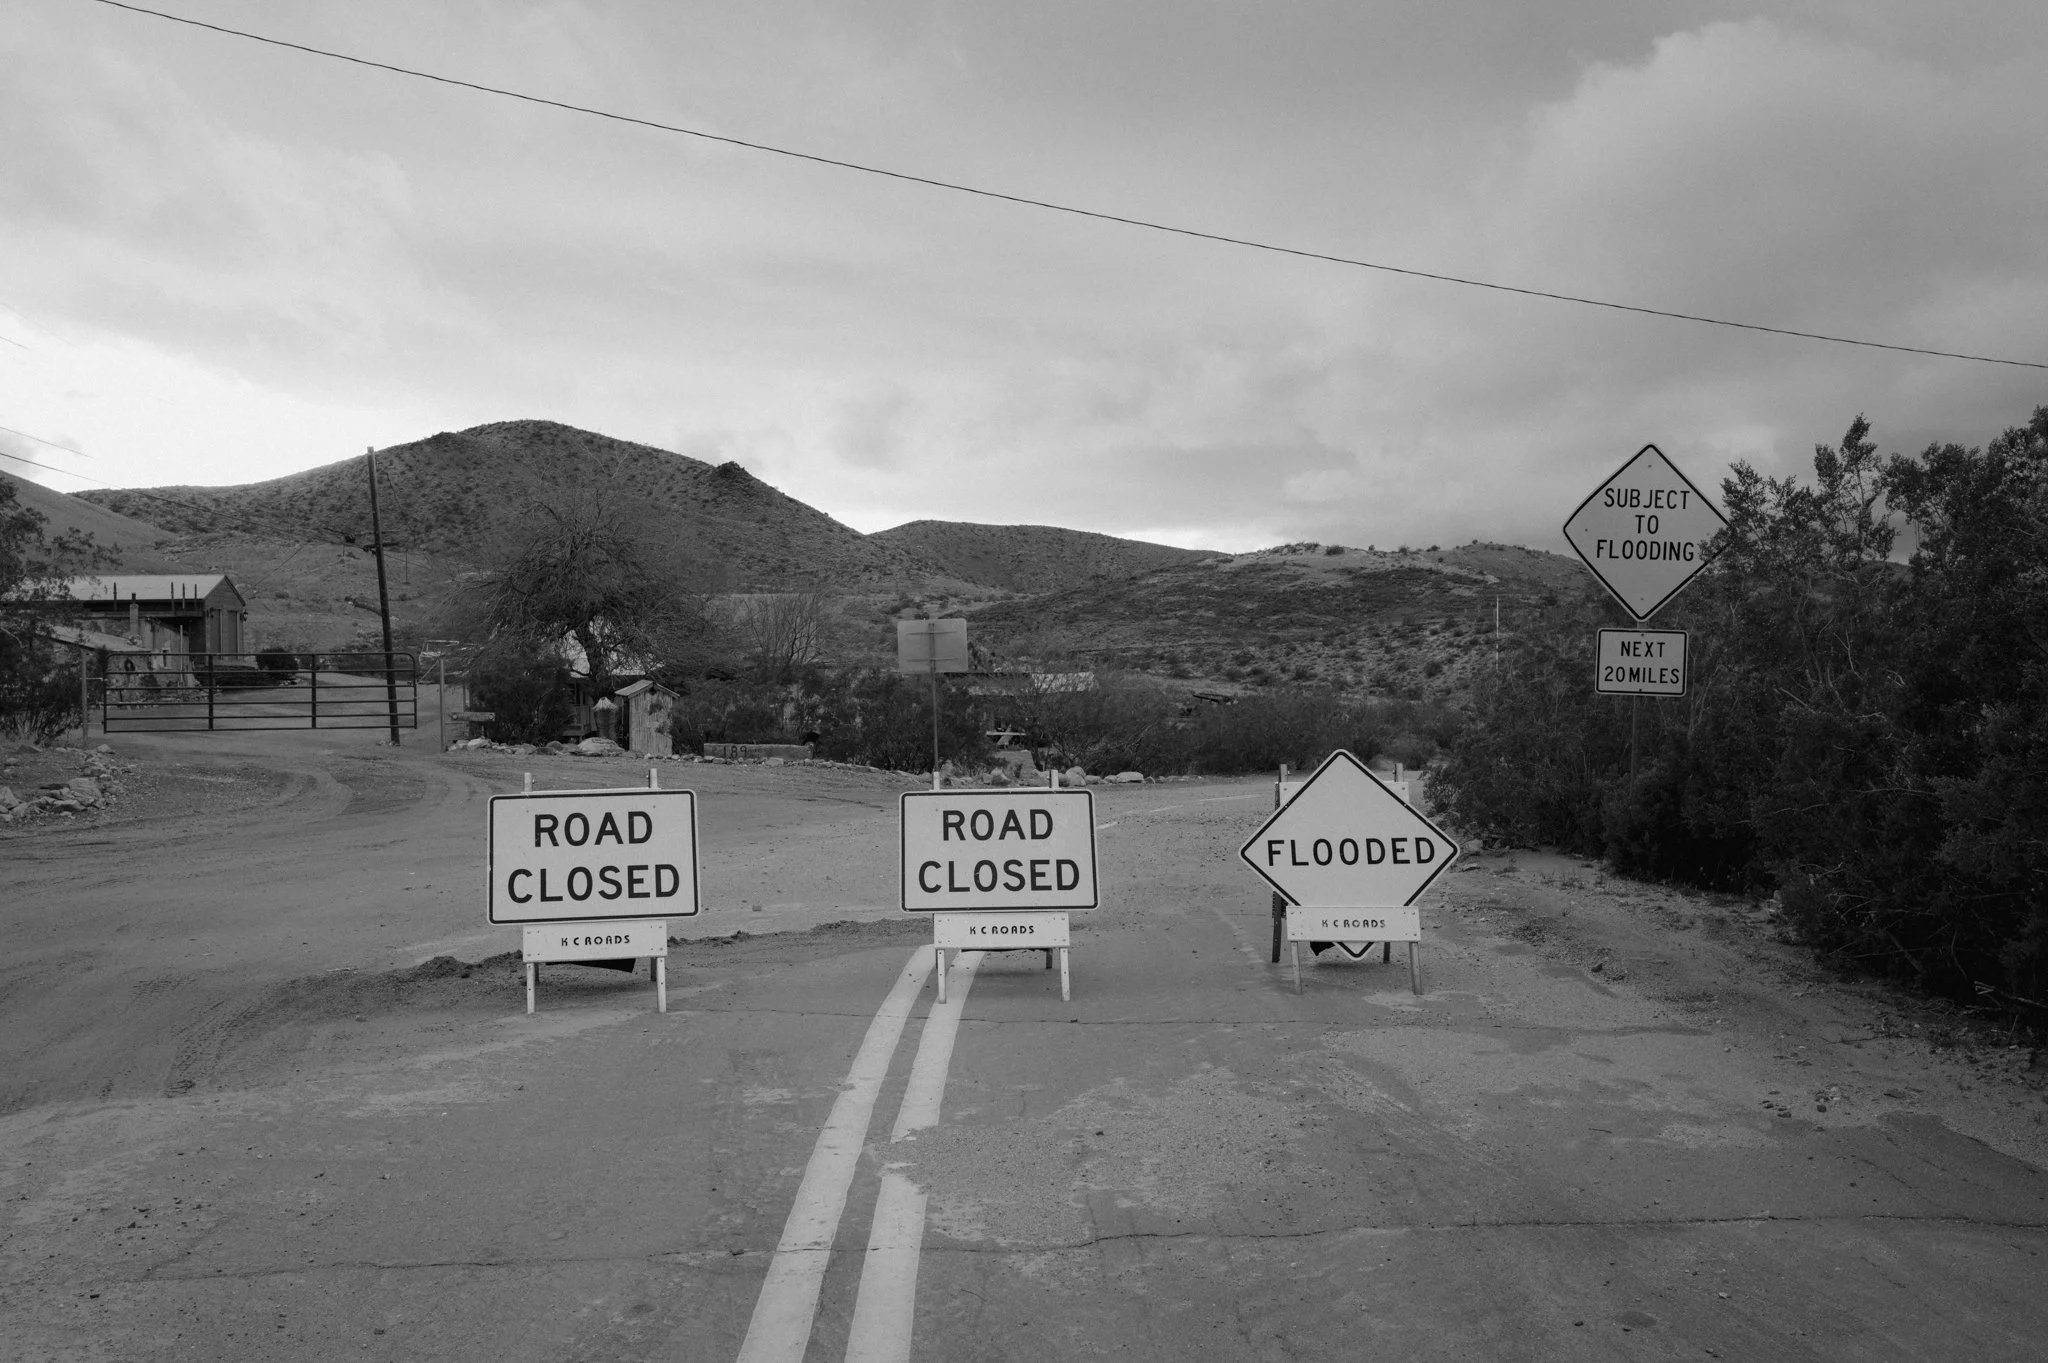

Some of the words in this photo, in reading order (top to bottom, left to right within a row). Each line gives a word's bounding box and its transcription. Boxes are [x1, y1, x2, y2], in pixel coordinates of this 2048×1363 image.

[1604, 488, 1690, 510] SUBJECT
[1635, 514, 1659, 535] TO
[1596, 539, 1694, 562] FLOODING
[1621, 641, 1665, 658] NEXT
[1604, 666, 1624, 682] 20
[1629, 667, 1680, 684] MILES
[535, 811, 653, 847] ROAD
[943, 809, 1053, 841] ROAD
[1267, 837, 1435, 866] FLOODED
[508, 864, 680, 904] CLOSED
[918, 859, 1080, 893] CLOSED
[991, 925, 1035, 935] ROADS
[1343, 919, 1386, 928] ROADS
[584, 935, 631, 946] ROADS
